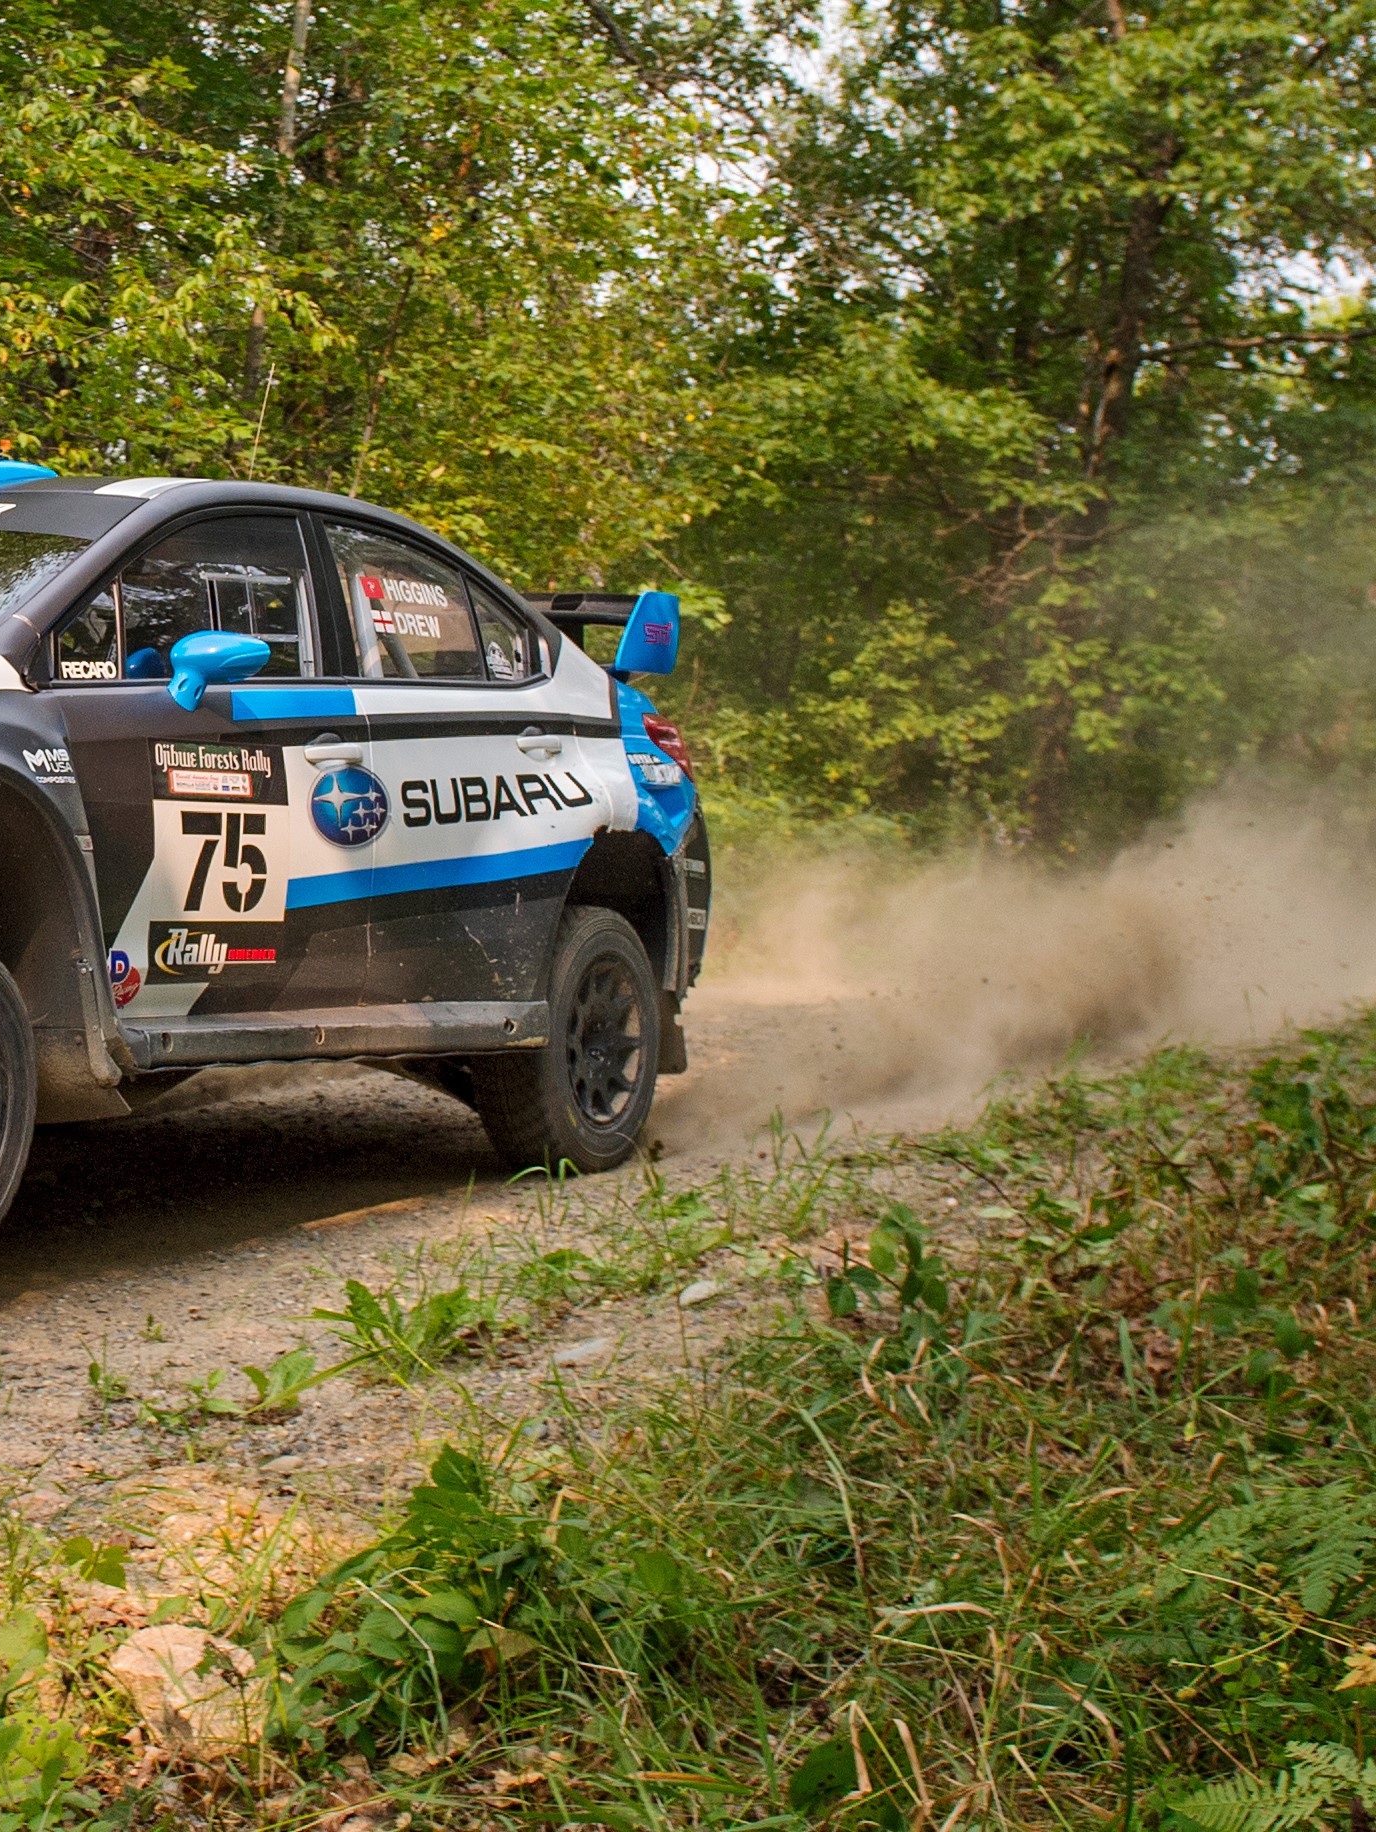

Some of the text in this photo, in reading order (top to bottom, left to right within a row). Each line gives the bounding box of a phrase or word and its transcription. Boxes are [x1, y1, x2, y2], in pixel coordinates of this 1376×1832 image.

[383, 578, 448, 608] HIGGINS
[393, 611, 441, 639] DREW
[61, 660, 117, 679] RECARO
[50, 761, 74, 773] USA
[154, 743, 271, 778] Ojibwe Forests Rally
[400, 771, 593, 828] SUBARU
[180, 810, 267, 913] 75
[167, 928, 229, 975] Rally
